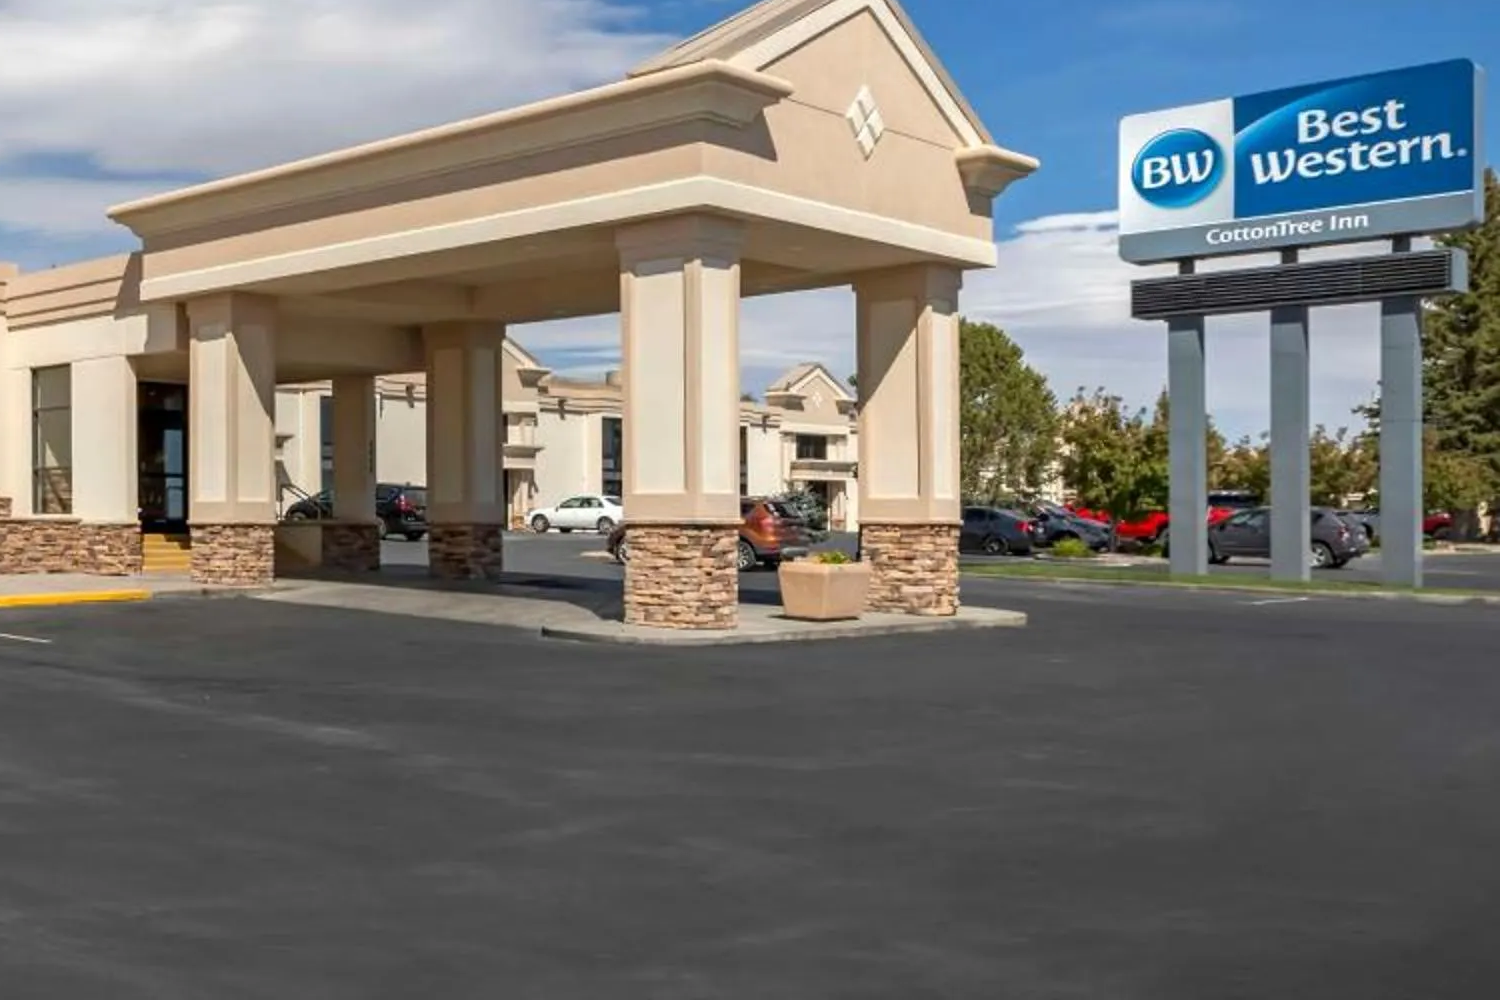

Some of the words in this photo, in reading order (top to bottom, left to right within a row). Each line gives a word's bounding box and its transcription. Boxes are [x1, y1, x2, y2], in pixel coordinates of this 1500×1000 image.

[1297, 99, 1406, 144] Best
[1142, 148, 1213, 189] BW
[1251, 131, 1454, 185] Western
[1206, 219, 1323, 246] CottonTree
[1330, 213, 1370, 231] Inn
